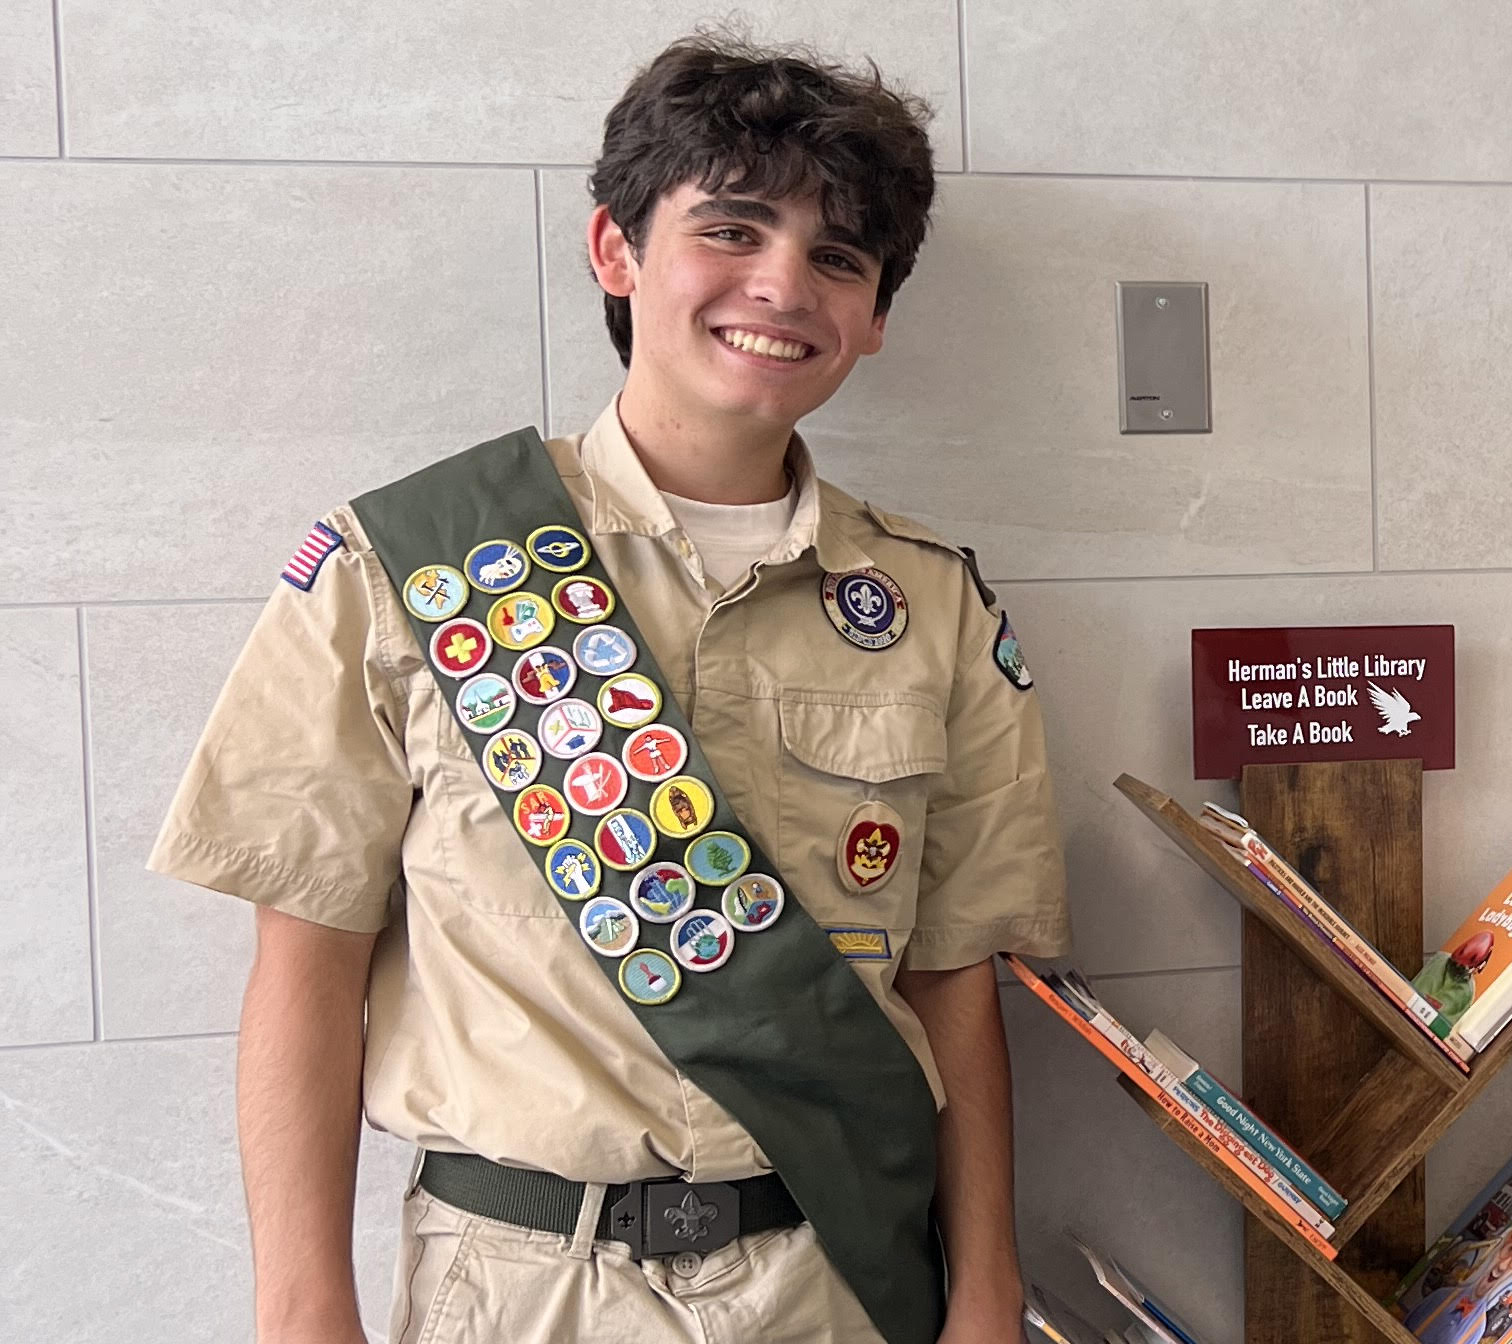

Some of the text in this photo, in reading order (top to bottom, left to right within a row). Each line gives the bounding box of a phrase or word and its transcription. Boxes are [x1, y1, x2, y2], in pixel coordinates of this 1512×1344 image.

[1228, 655, 1425, 682] Herman's Little Library
[1242, 684, 1358, 710] Leave A Book
[1248, 721, 1353, 746] Take A Book
[1156, 1091, 1222, 1153] How to Raise a Mom
[1214, 1094, 1314, 1185] Good Night New York State
[1197, 1108, 1217, 1127] The
[1252, 1159, 1277, 1183] Dog
